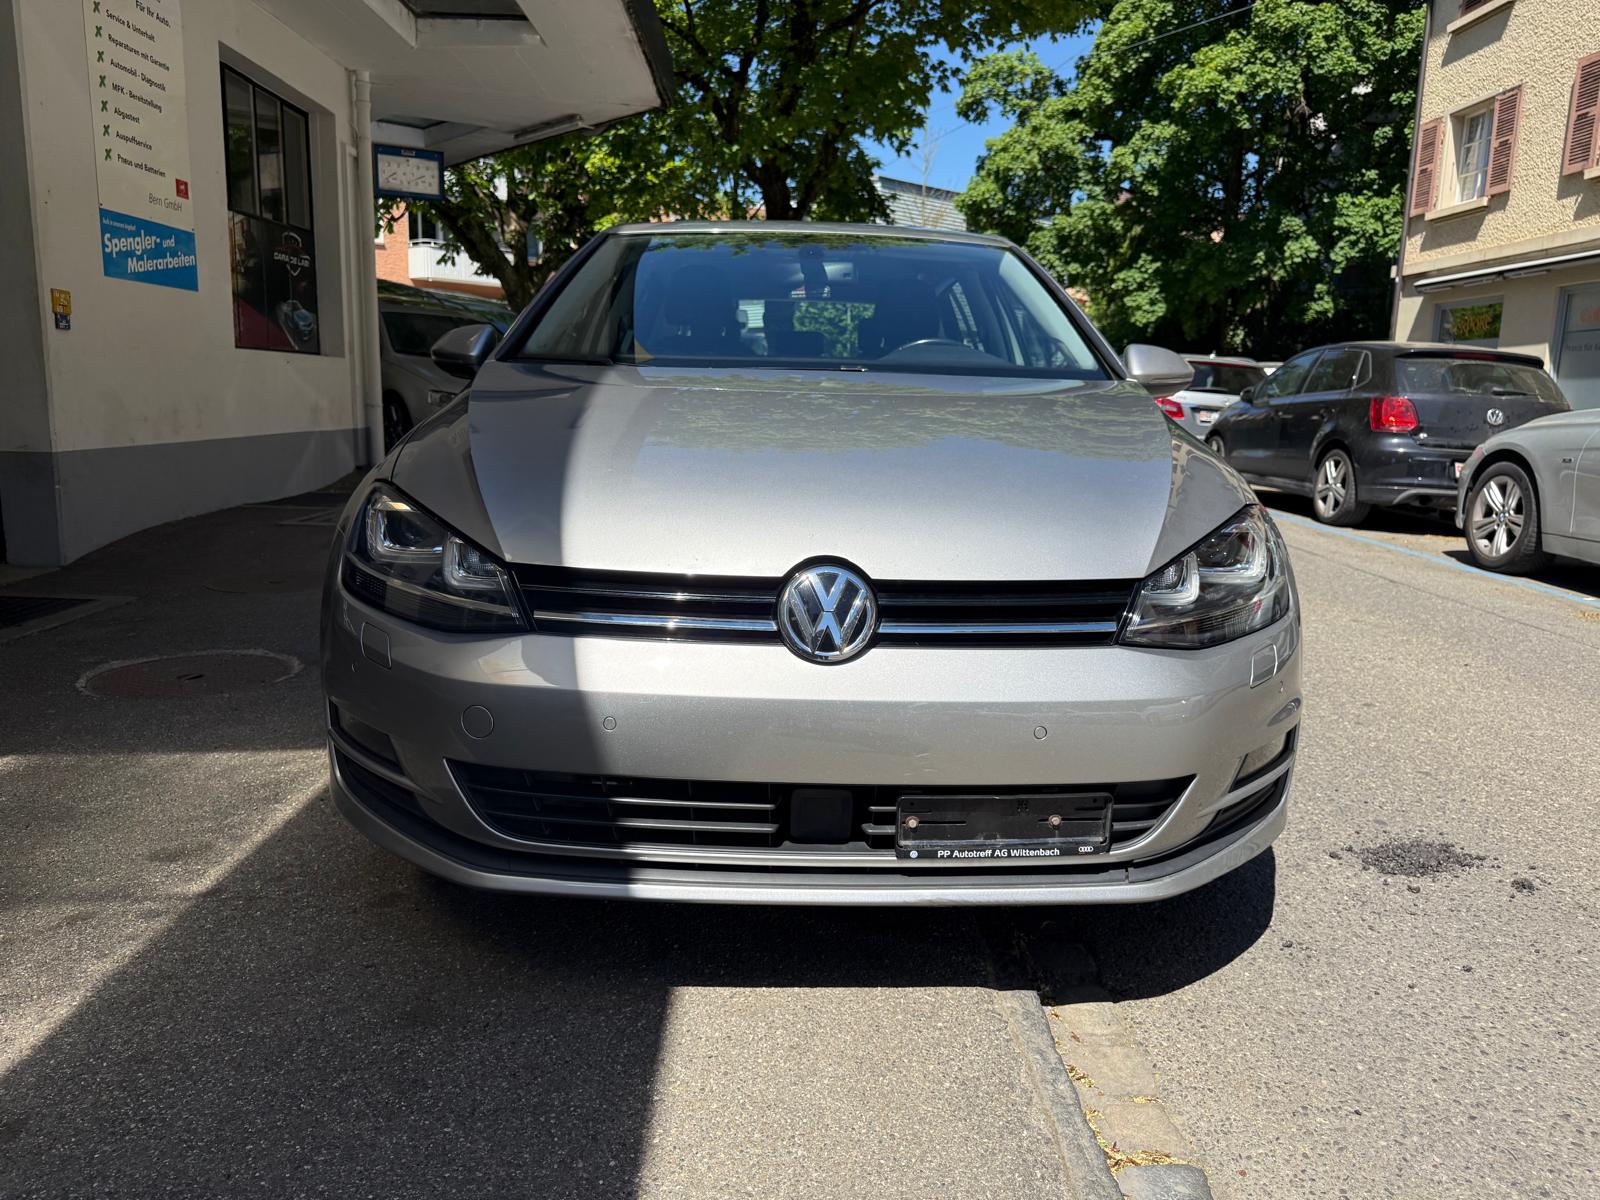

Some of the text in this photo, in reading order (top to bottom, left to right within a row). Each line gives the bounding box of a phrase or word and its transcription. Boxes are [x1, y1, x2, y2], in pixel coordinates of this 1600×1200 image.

[105, 9, 126, 26] Service
[126, 20, 131, 29] &
[146, 6, 154, 18] Ihr
[108, 33, 170, 72] Reparaturen mit Garantie
[110, 58, 137, 78] Automobil
[141, 72, 166, 92] Diagnostik
[112, 82, 125, 96] MFK
[128, 90, 162, 113] Bereitstellung
[113, 107, 140, 124] Abgastest
[115, 130, 152, 151] Auspuffservice
[117, 153, 166, 178] Pneus und Batterien
[148, 193, 183, 213] Bern GmbH
[104, 229, 176, 258] Spengler- und
[127, 251, 196, 274] Malerarbeiten
[780, 565, 876, 661] VW
[937, 847, 1060, 858] PP Autotreff AG Wittenbach
